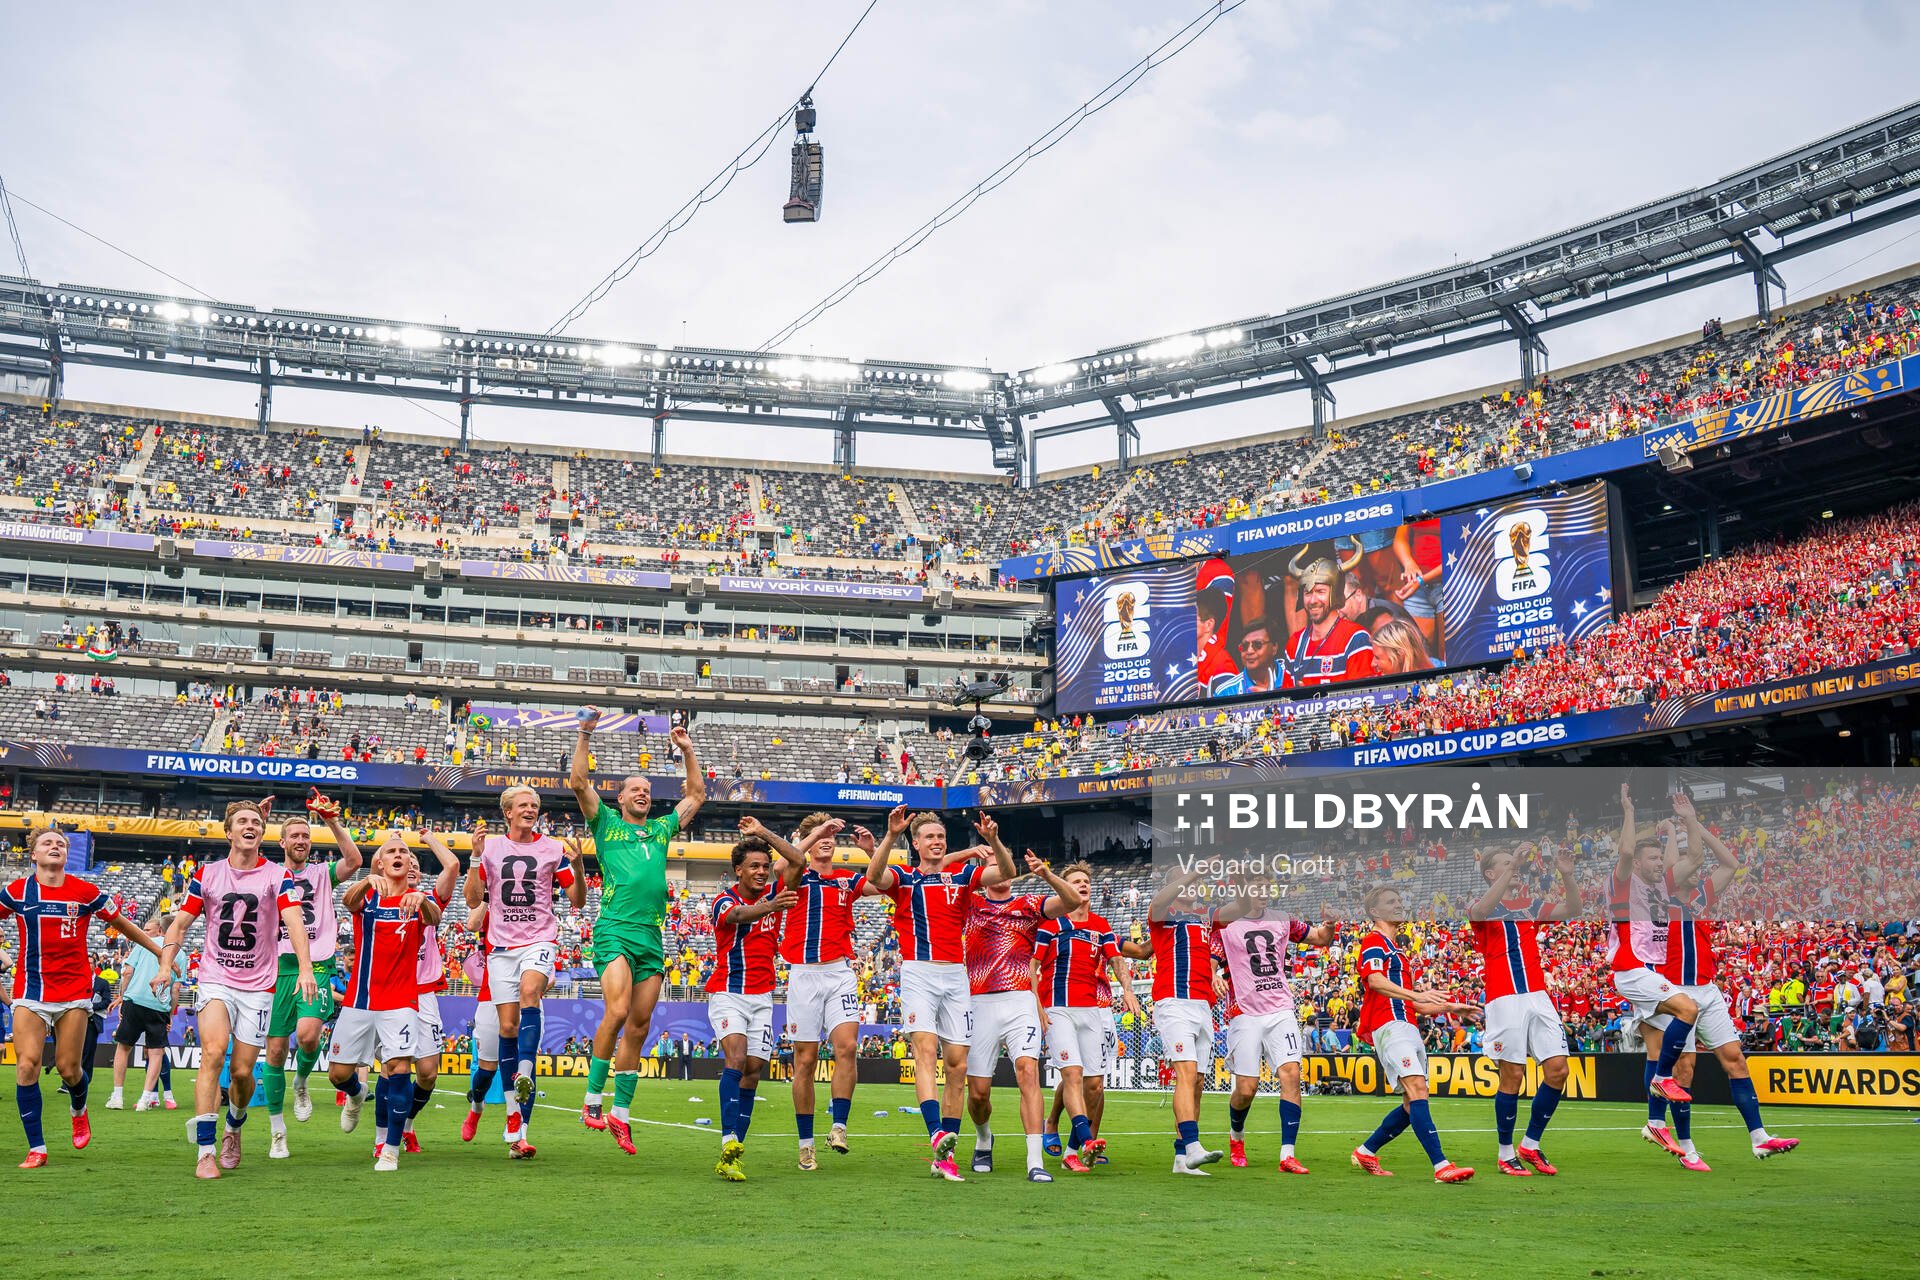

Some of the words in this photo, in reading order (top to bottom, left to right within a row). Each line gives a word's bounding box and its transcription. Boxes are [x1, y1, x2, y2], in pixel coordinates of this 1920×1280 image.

[1237, 528, 1264, 543] FIFA
[1266, 519, 1313, 537] WORLD
[1315, 514, 1342, 529] CUP
[1344, 503, 1393, 523] 2026
[0, 523, 83, 543] #FIFAWorldCup
[729, 580, 764, 590] NEW
[768, 581, 810, 592] YORK
[814, 583, 849, 594] NEW
[853, 585, 912, 597] JERSEY
[1512, 580, 1536, 592] FIFA
[1497, 601, 1532, 614] WORLD
[1533, 597, 1553, 608] CUP
[1497, 607, 1553, 628] 2026
[1495, 630, 1522, 643] NEW
[1525, 624, 1557, 638] YORK
[1117, 642, 1138, 652] FIFA
[1489, 641, 1515, 654] NEW
[1519, 633, 1564, 649] JERSEY
[1104, 660, 1134, 670] WORLD
[1135, 659, 1151, 668] CUP
[1104, 668, 1151, 683] 2026
[1101, 686, 1124, 695] NEW
[1127, 682, 1154, 693] YORK
[1714, 693, 1756, 712] NEW
[1759, 685, 1809, 706] YORK
[1812, 675, 1854, 697] NEW
[1858, 663, 1920, 688] JERSE
[1095, 695, 1118, 705] NEW
[1121, 690, 1160, 703] JERSEY
[1296, 702, 1323, 715] CUP
[1326, 695, 1375, 711] 2026
[1354, 748, 1391, 766] FIFA
[1393, 739, 1457, 760] WORLD
[1460, 734, 1498, 751] CUP
[1500, 723, 1566, 747] 2026
[147, 755, 186, 770] FIFA
[189, 758, 254, 774] WORLD
[257, 762, 292, 777] CUP
[295, 764, 358, 779] 2026
[486, 775, 519, 787] NEW
[522, 776, 560, 788] YORK
[1078, 780, 1108, 793] NEW
[1111, 777, 1146, 791] YORK
[1148, 773, 1177, 787] NEW
[1179, 767, 1232, 784] JERSEY
[838, 789, 903, 804] #FIFAWorldCup
[944, 886, 959, 905] 17
[503, 914, 536, 922] 2026
[61, 918, 77, 939] 21
[395, 923, 406, 942] 4
[227, 939, 246, 947] FIFA
[216, 958, 255, 969] 2026
[1255, 982, 1284, 992] 2026
[399, 1024, 410, 1043] 4
[1027, 1026, 1036, 1043] 7
[1284, 1033, 1298, 1050] 11
[134, 1046, 202, 1069] LVE
[1428, 1056, 1597, 1098] PASIN
[1769, 1068, 1920, 1096] REWARDS
